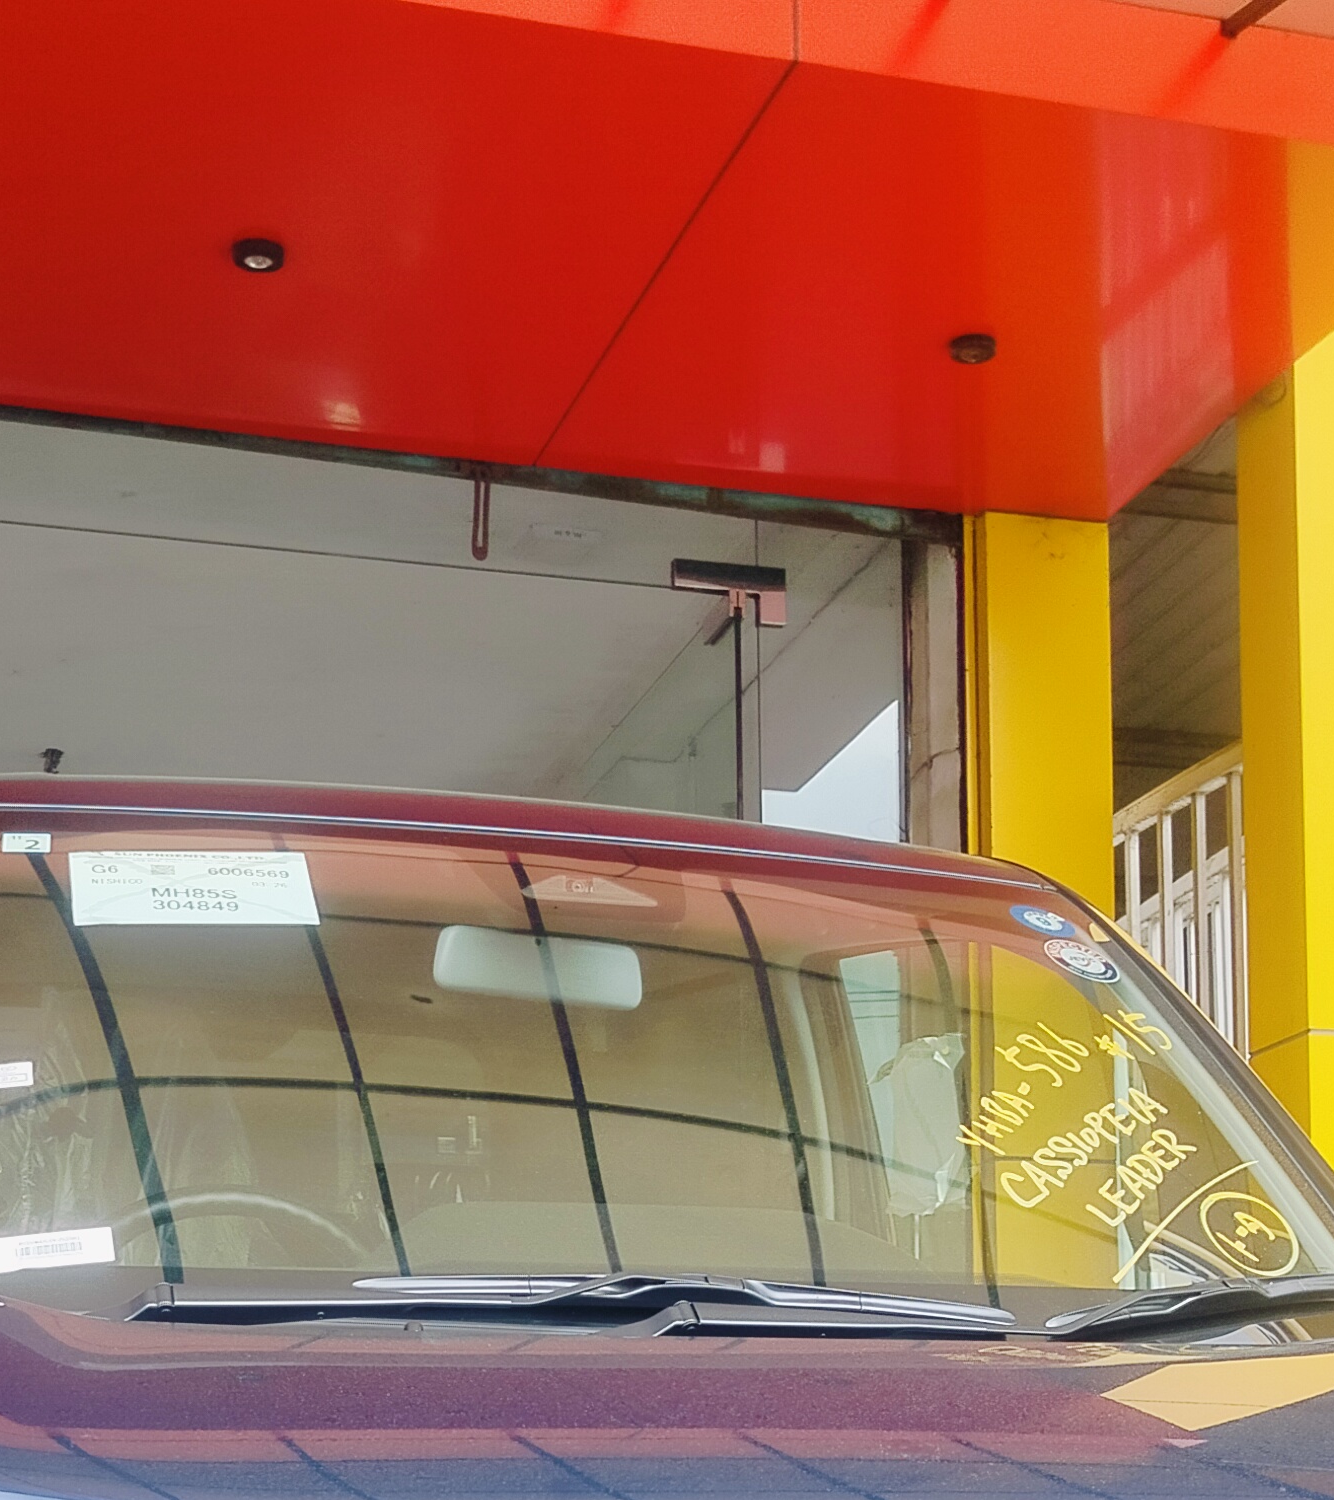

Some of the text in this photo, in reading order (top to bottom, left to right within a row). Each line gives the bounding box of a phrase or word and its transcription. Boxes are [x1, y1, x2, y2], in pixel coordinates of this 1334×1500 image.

[24, 838, 41, 851] 2
[91, 864, 119, 874] G6
[207, 867, 290, 879] 6006569
[151, 887, 238, 900] MH85S
[152, 900, 240, 912] 304849
[1085, 1128, 1198, 1227] LEADER
